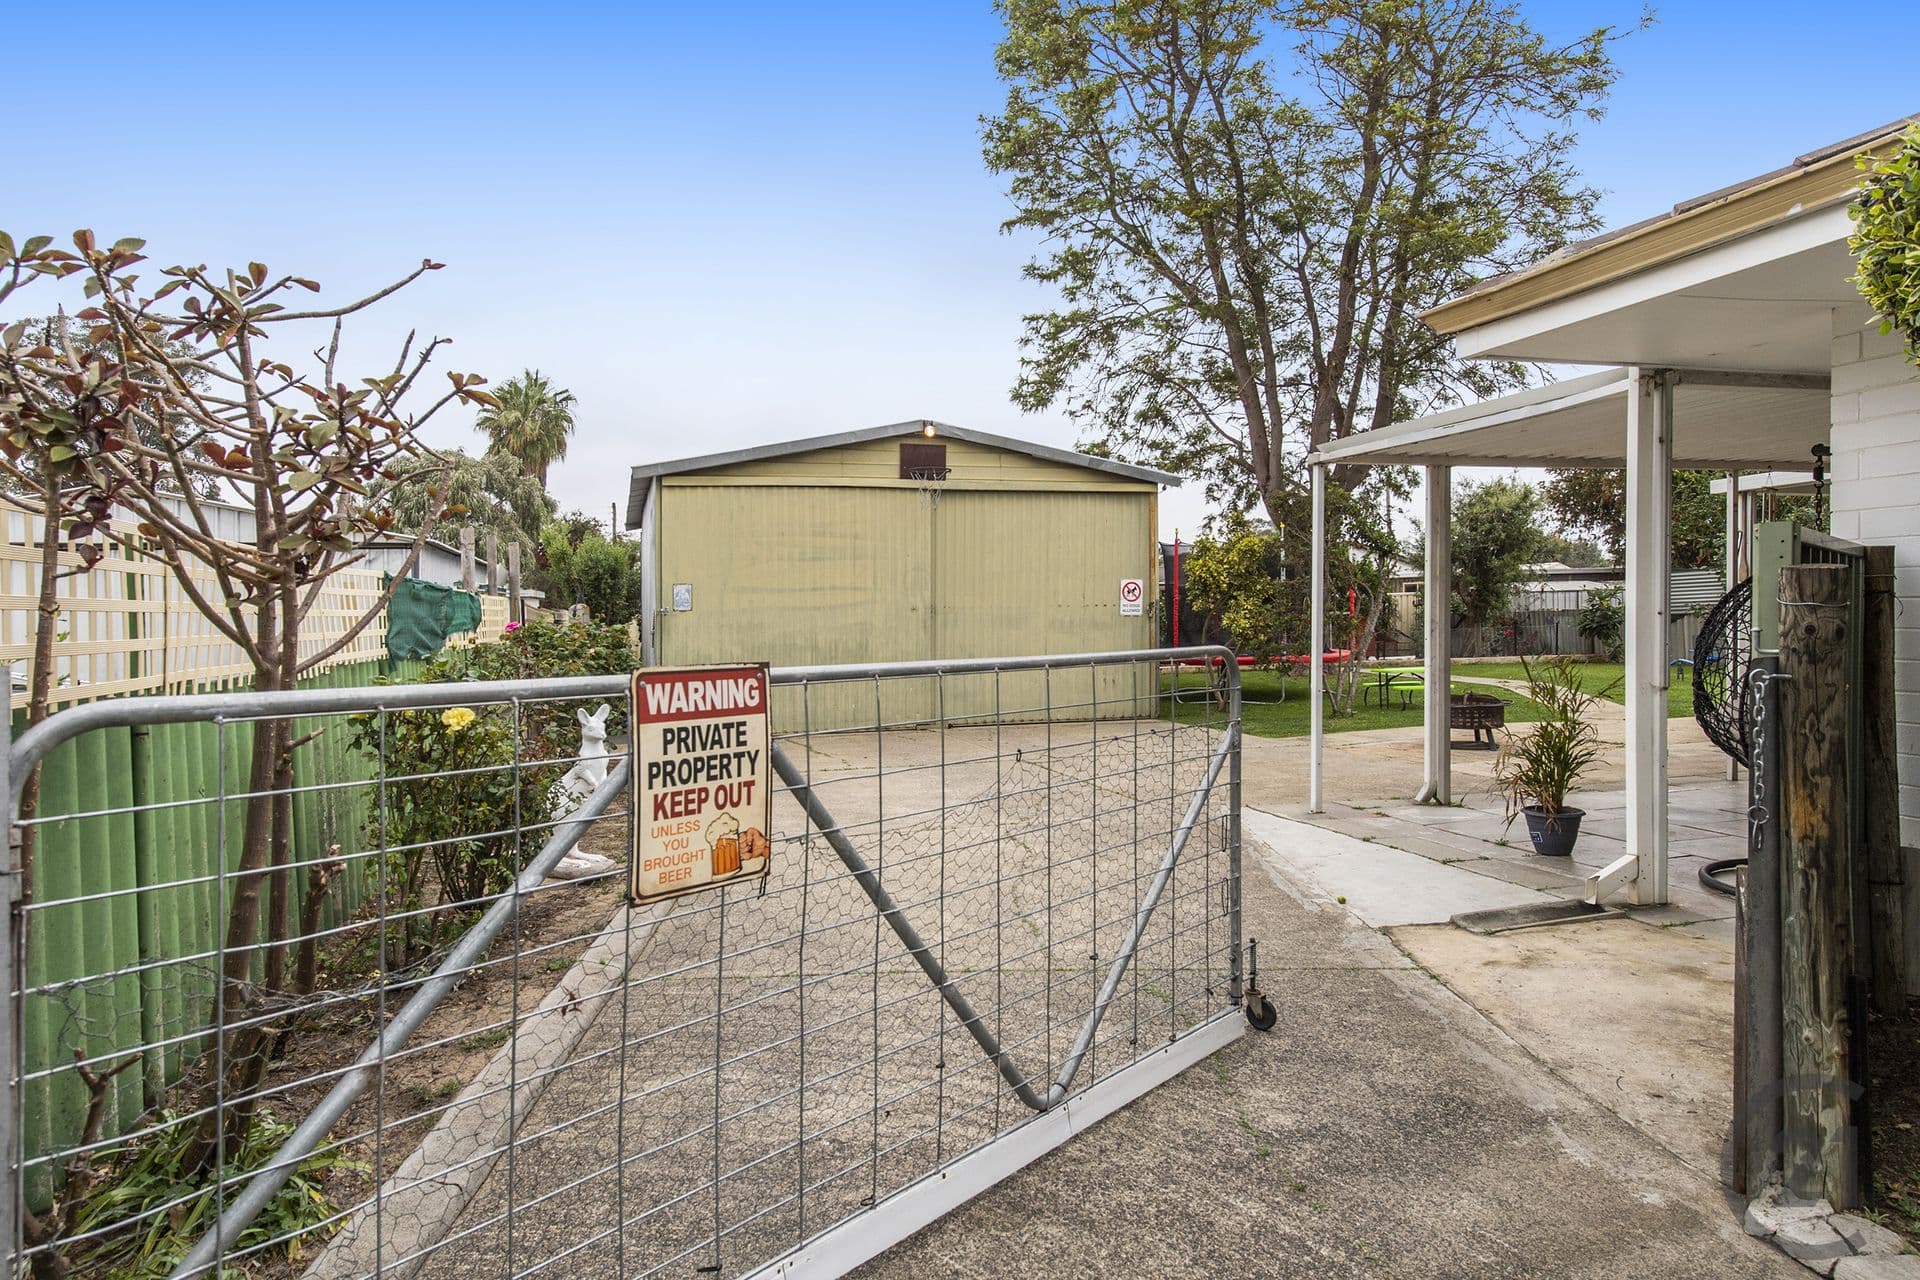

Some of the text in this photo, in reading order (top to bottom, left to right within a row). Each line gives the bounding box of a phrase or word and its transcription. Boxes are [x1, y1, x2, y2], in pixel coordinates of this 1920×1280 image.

[645, 678, 760, 715] WARNING
[663, 720, 747, 756] PRIVATE
[648, 749, 760, 790] PROPERTY
[653, 779, 756, 822] KEEP OUT
[651, 819, 701, 839] UNLESS
[662, 836, 689, 852] YOU
[644, 848, 706, 872] BROUGHT
[659, 867, 692, 884] BEER
